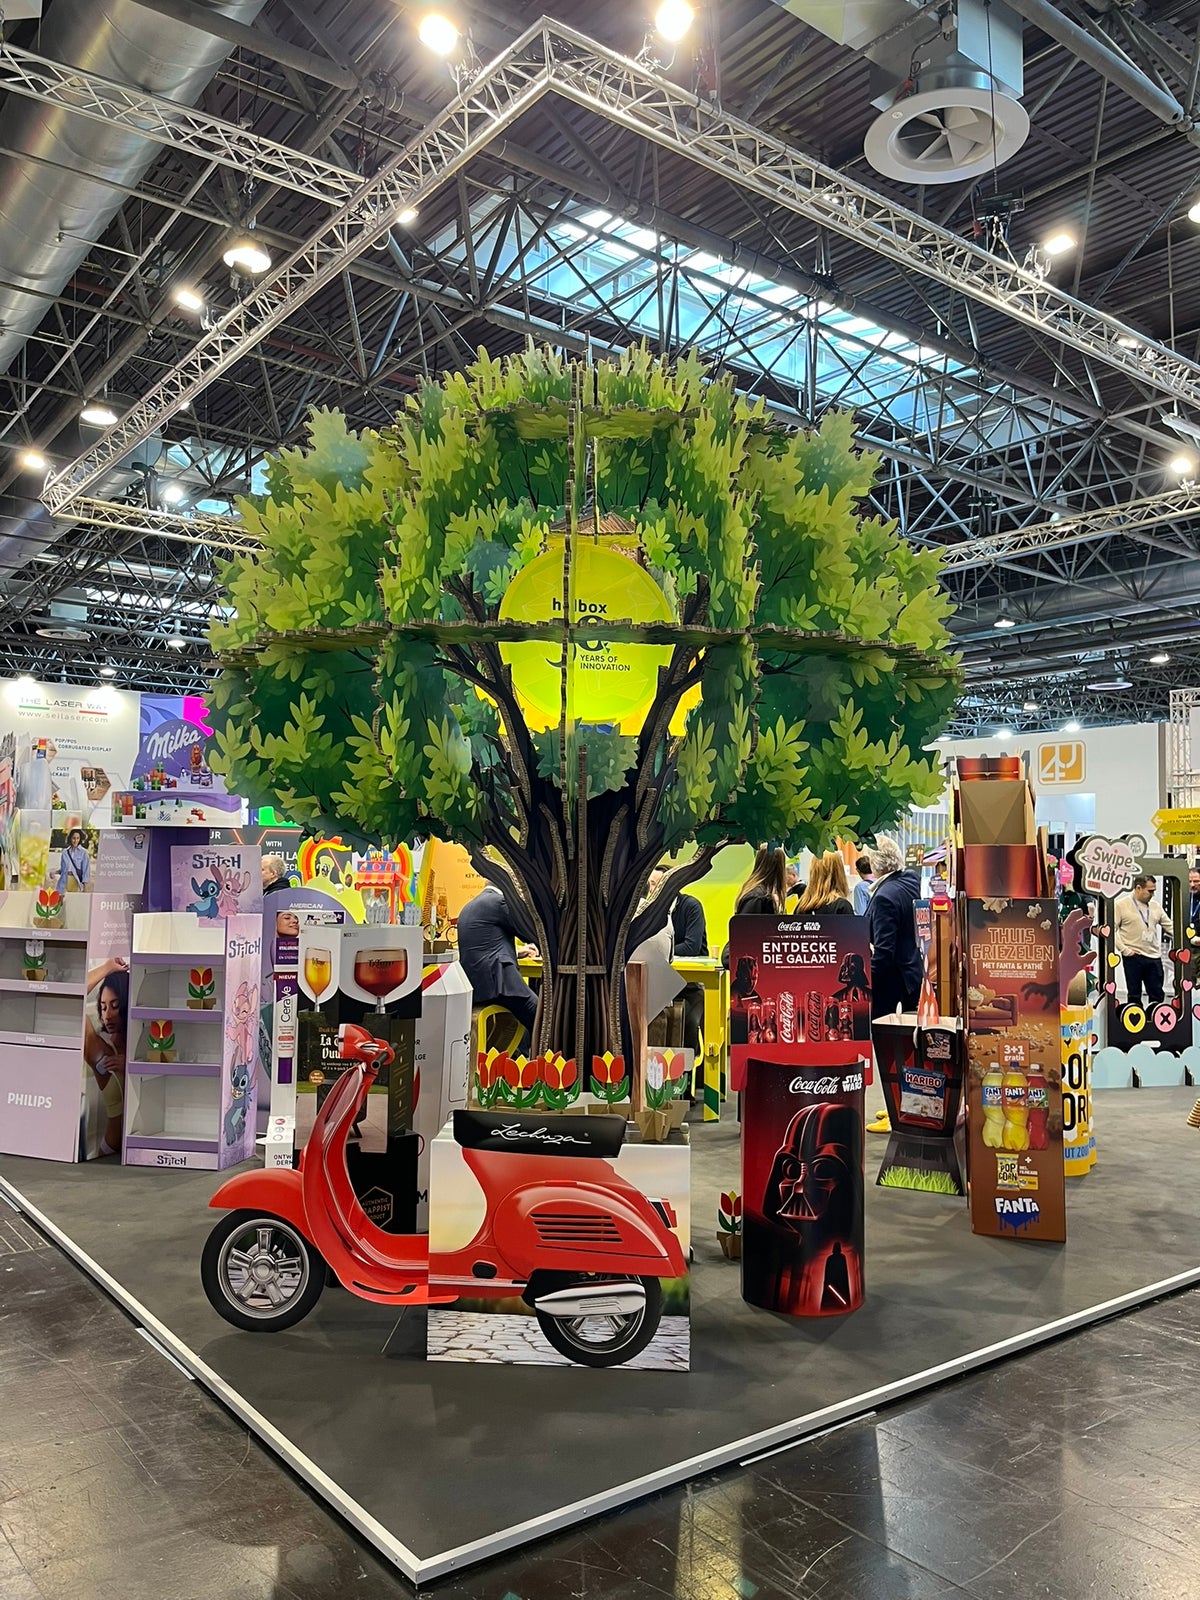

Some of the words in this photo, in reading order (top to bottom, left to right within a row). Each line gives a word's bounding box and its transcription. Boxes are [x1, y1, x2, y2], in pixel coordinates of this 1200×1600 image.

[552, 597, 608, 614] hlbox
[580, 654, 605, 663] YEARS
[580, 662, 631, 672] INNOVATION
[46, 699, 83, 708] LASER
[18, 710, 109, 724] www.seilaser.com
[146, 726, 202, 760] Milka
[102, 832, 126, 840] PHILIPS
[1092, 846, 1132, 869] Swipe
[1106, 864, 1112, 872] &
[1088, 865, 1131, 886] Match
[100, 901, 135, 911] PHILIPS
[777, 922, 802, 932] Coca-Cola
[988, 927, 1036, 944] THUIS
[762, 942, 836, 952] ENTDECKE
[970, 944, 1054, 962] GRIEZELEN
[763, 954, 783, 964] DIE
[786, 954, 837, 964] GALAXIE
[996, 962, 1016, 970] FANTA
[1023, 962, 1044, 970] PATHÉ
[281, 986, 292, 1022] CeraVe
[780, 992, 794, 1043] Coca-Cola
[808, 992, 822, 1042] Coca-Cola
[320, 1034, 332, 1046] La
[1004, 1045, 1024, 1054] 3+1
[1004, 1054, 1024, 1062] gratis
[842, 1073, 862, 1084] STAR
[905, 1072, 942, 1088] HARIBO
[788, 1076, 840, 1094] Coca-Cola
[842, 1081, 862, 1092] WARS
[985, 1087, 1002, 1096] FANT
[1005, 1088, 1025, 1096] FANTA
[1028, 1089, 1045, 1098] ANTA
[8, 1092, 52, 1109] PHILIPS
[490, 1122, 592, 1144] Lechuza
[1000, 1163, 1016, 1172] POP
[998, 1172, 1018, 1182] CORN
[362, 1197, 388, 1206] AUTHENTIC
[995, 1198, 1040, 1214] FANTA
